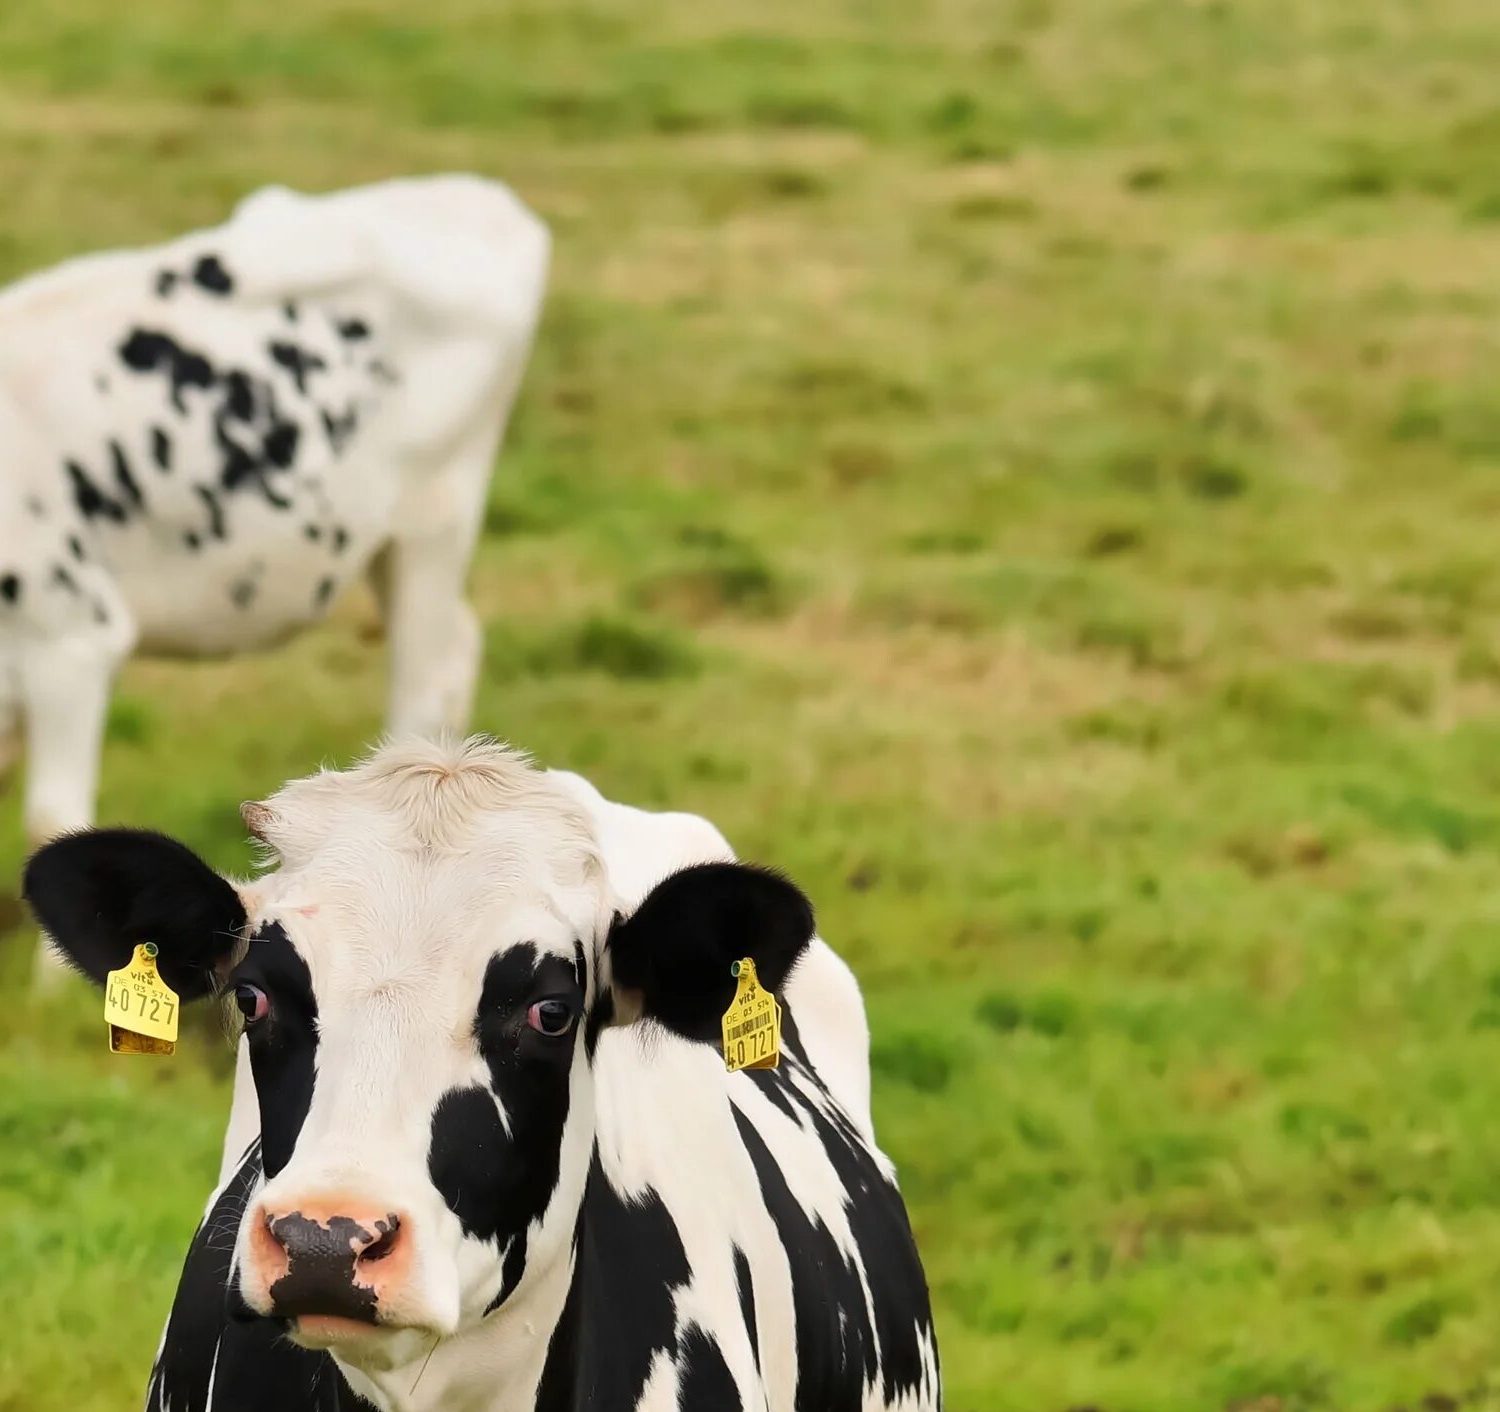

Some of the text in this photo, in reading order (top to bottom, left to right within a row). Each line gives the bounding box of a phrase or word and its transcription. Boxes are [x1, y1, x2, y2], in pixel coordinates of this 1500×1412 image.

[109, 983, 175, 1025] 40 727
[726, 1012, 739, 1025] DE
[727, 1025, 774, 1069] 40 727
